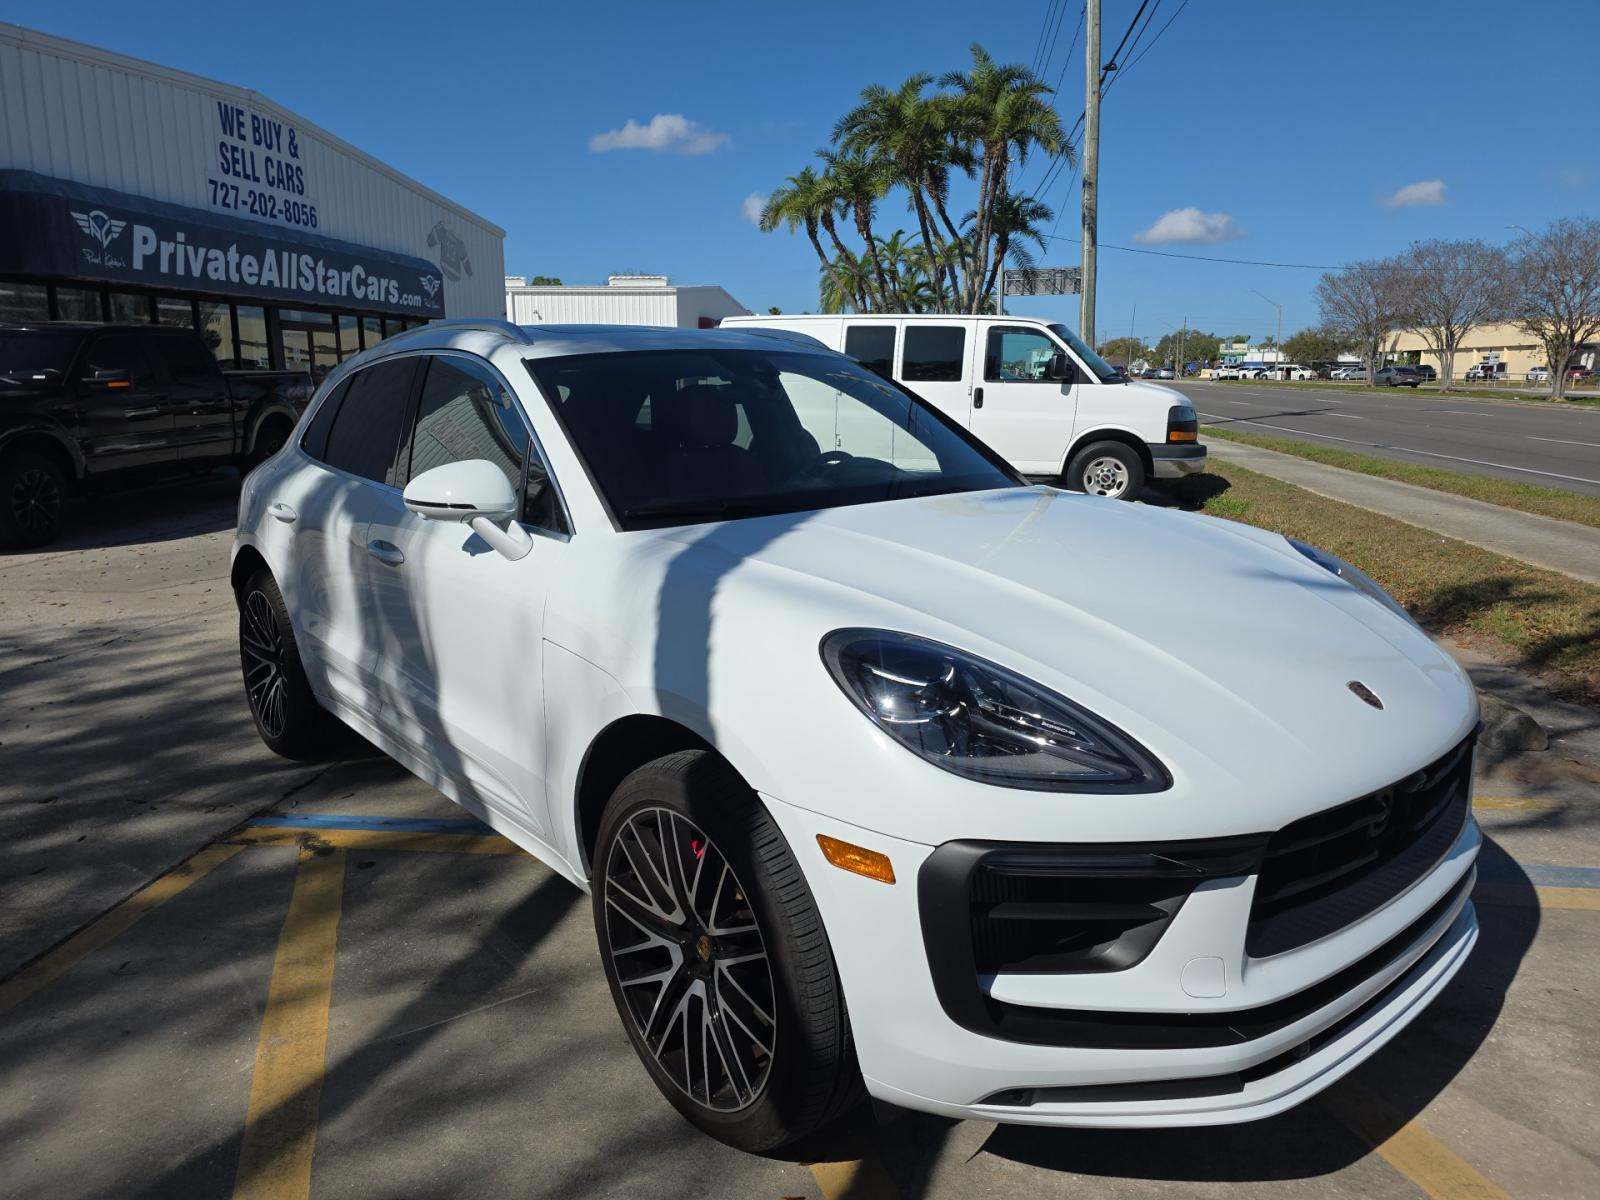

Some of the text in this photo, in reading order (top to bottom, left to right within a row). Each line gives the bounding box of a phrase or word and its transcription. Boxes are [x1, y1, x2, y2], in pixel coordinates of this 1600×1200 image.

[217, 101, 300, 160] WE BUY &
[219, 141, 305, 196] SELL CARS
[208, 178, 318, 229] 727-202-8056
[132, 224, 422, 308] PrivateAllStarCars.com
